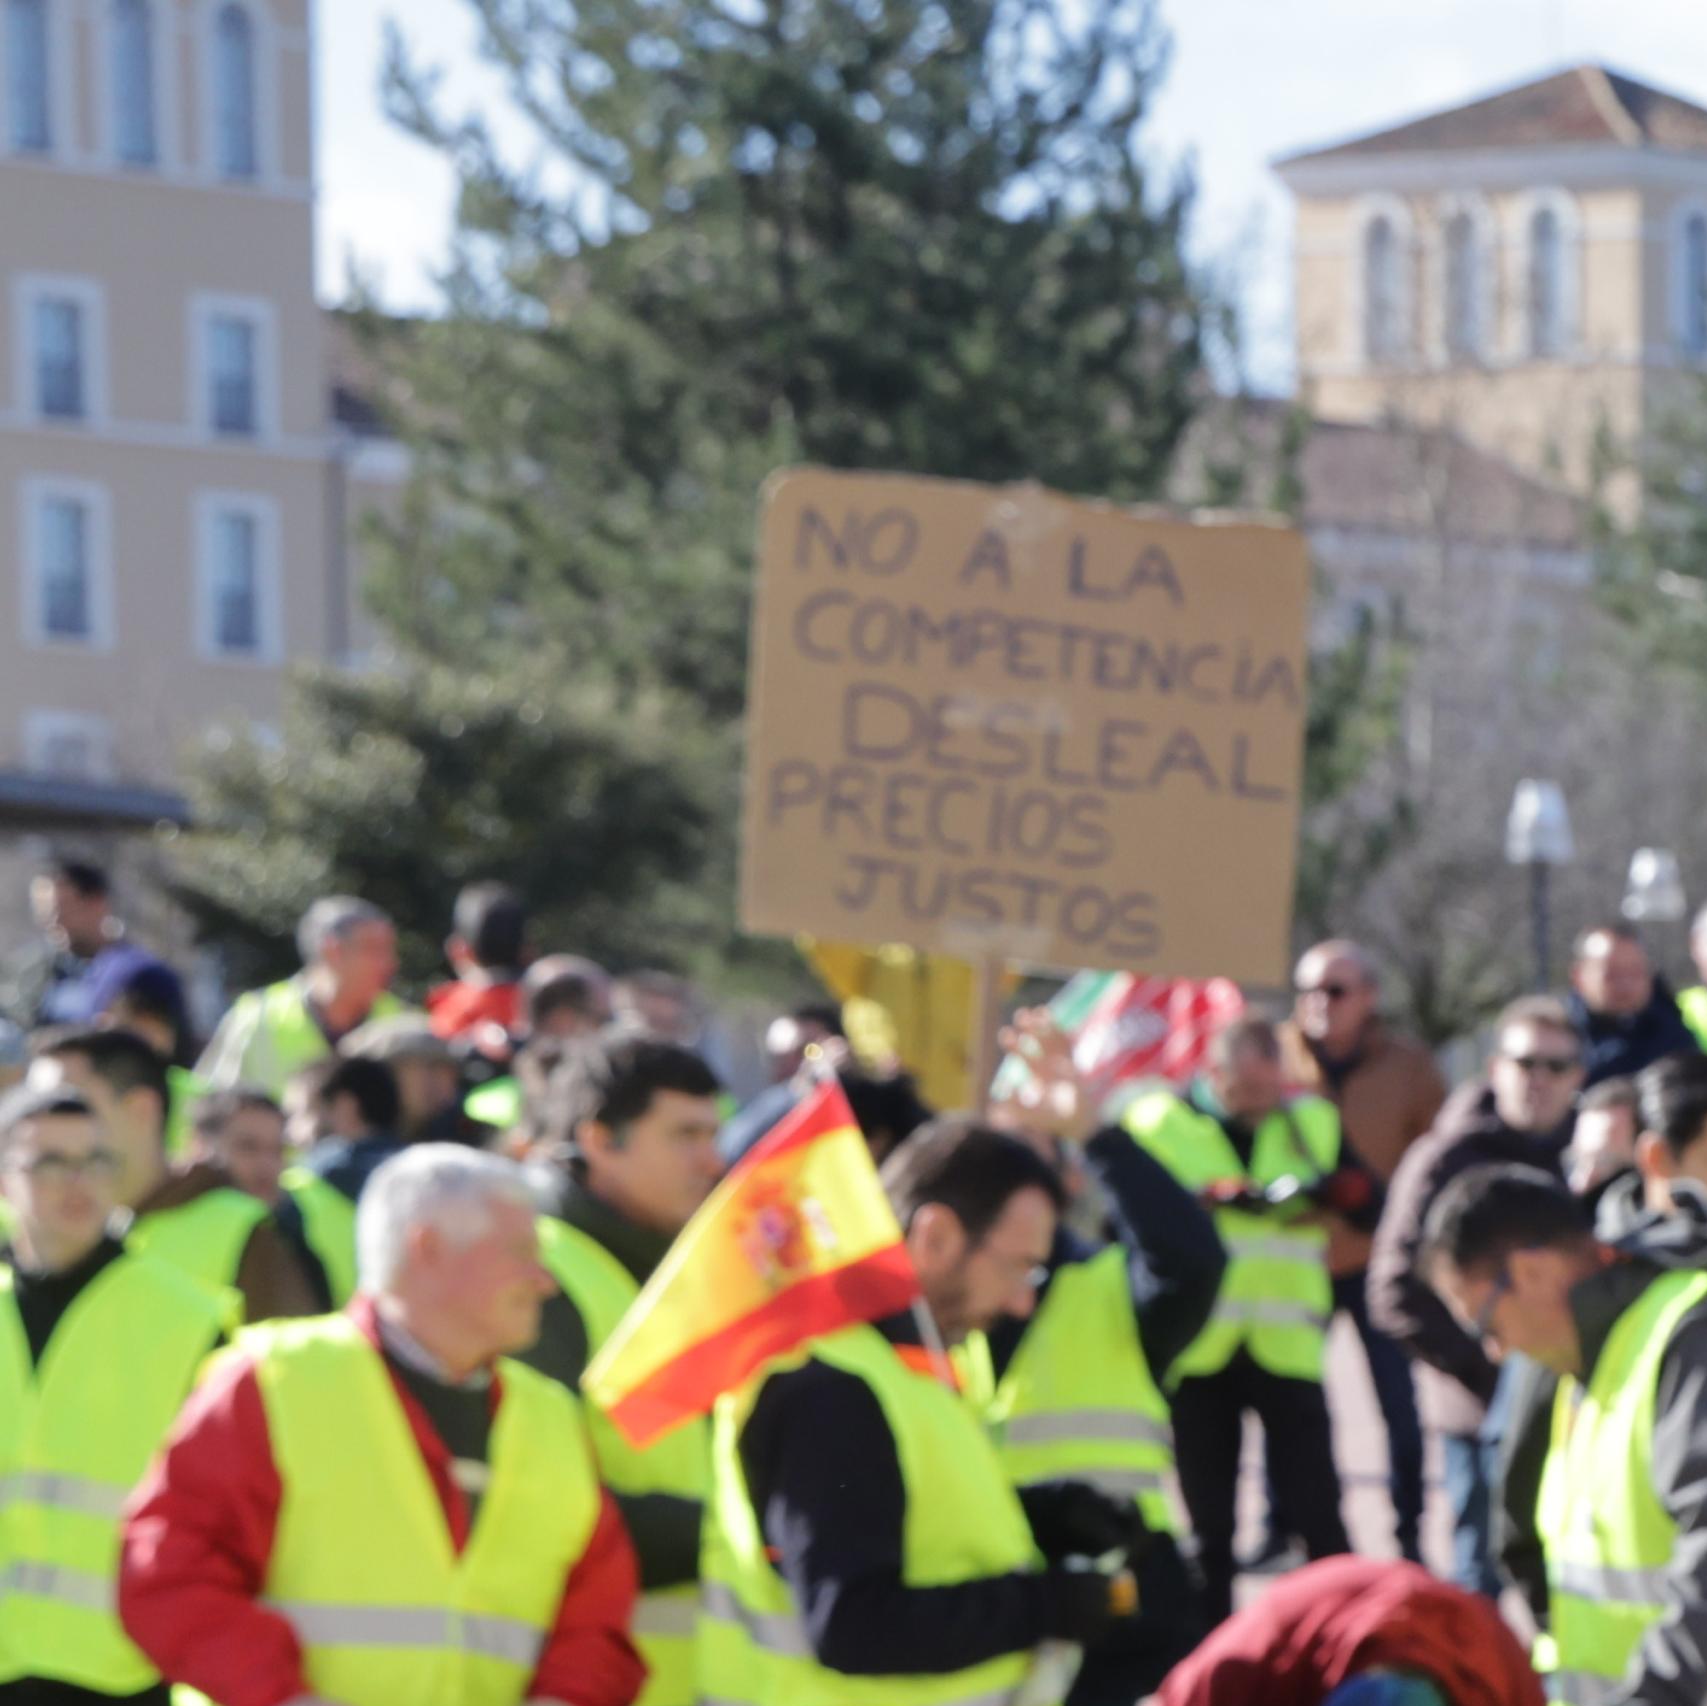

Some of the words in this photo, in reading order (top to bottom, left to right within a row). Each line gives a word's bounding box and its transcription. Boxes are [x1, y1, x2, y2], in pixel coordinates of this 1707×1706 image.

[793, 505, 920, 575] NO
[959, 526, 1013, 591] A
[1065, 534, 1187, 609] LA
[793, 588, 1302, 709] COMPETENCIA
[842, 680, 1289, 802] DESLEAL
[766, 760, 1112, 870] PRECIOS
[836, 854, 1162, 960] JUSTOS
